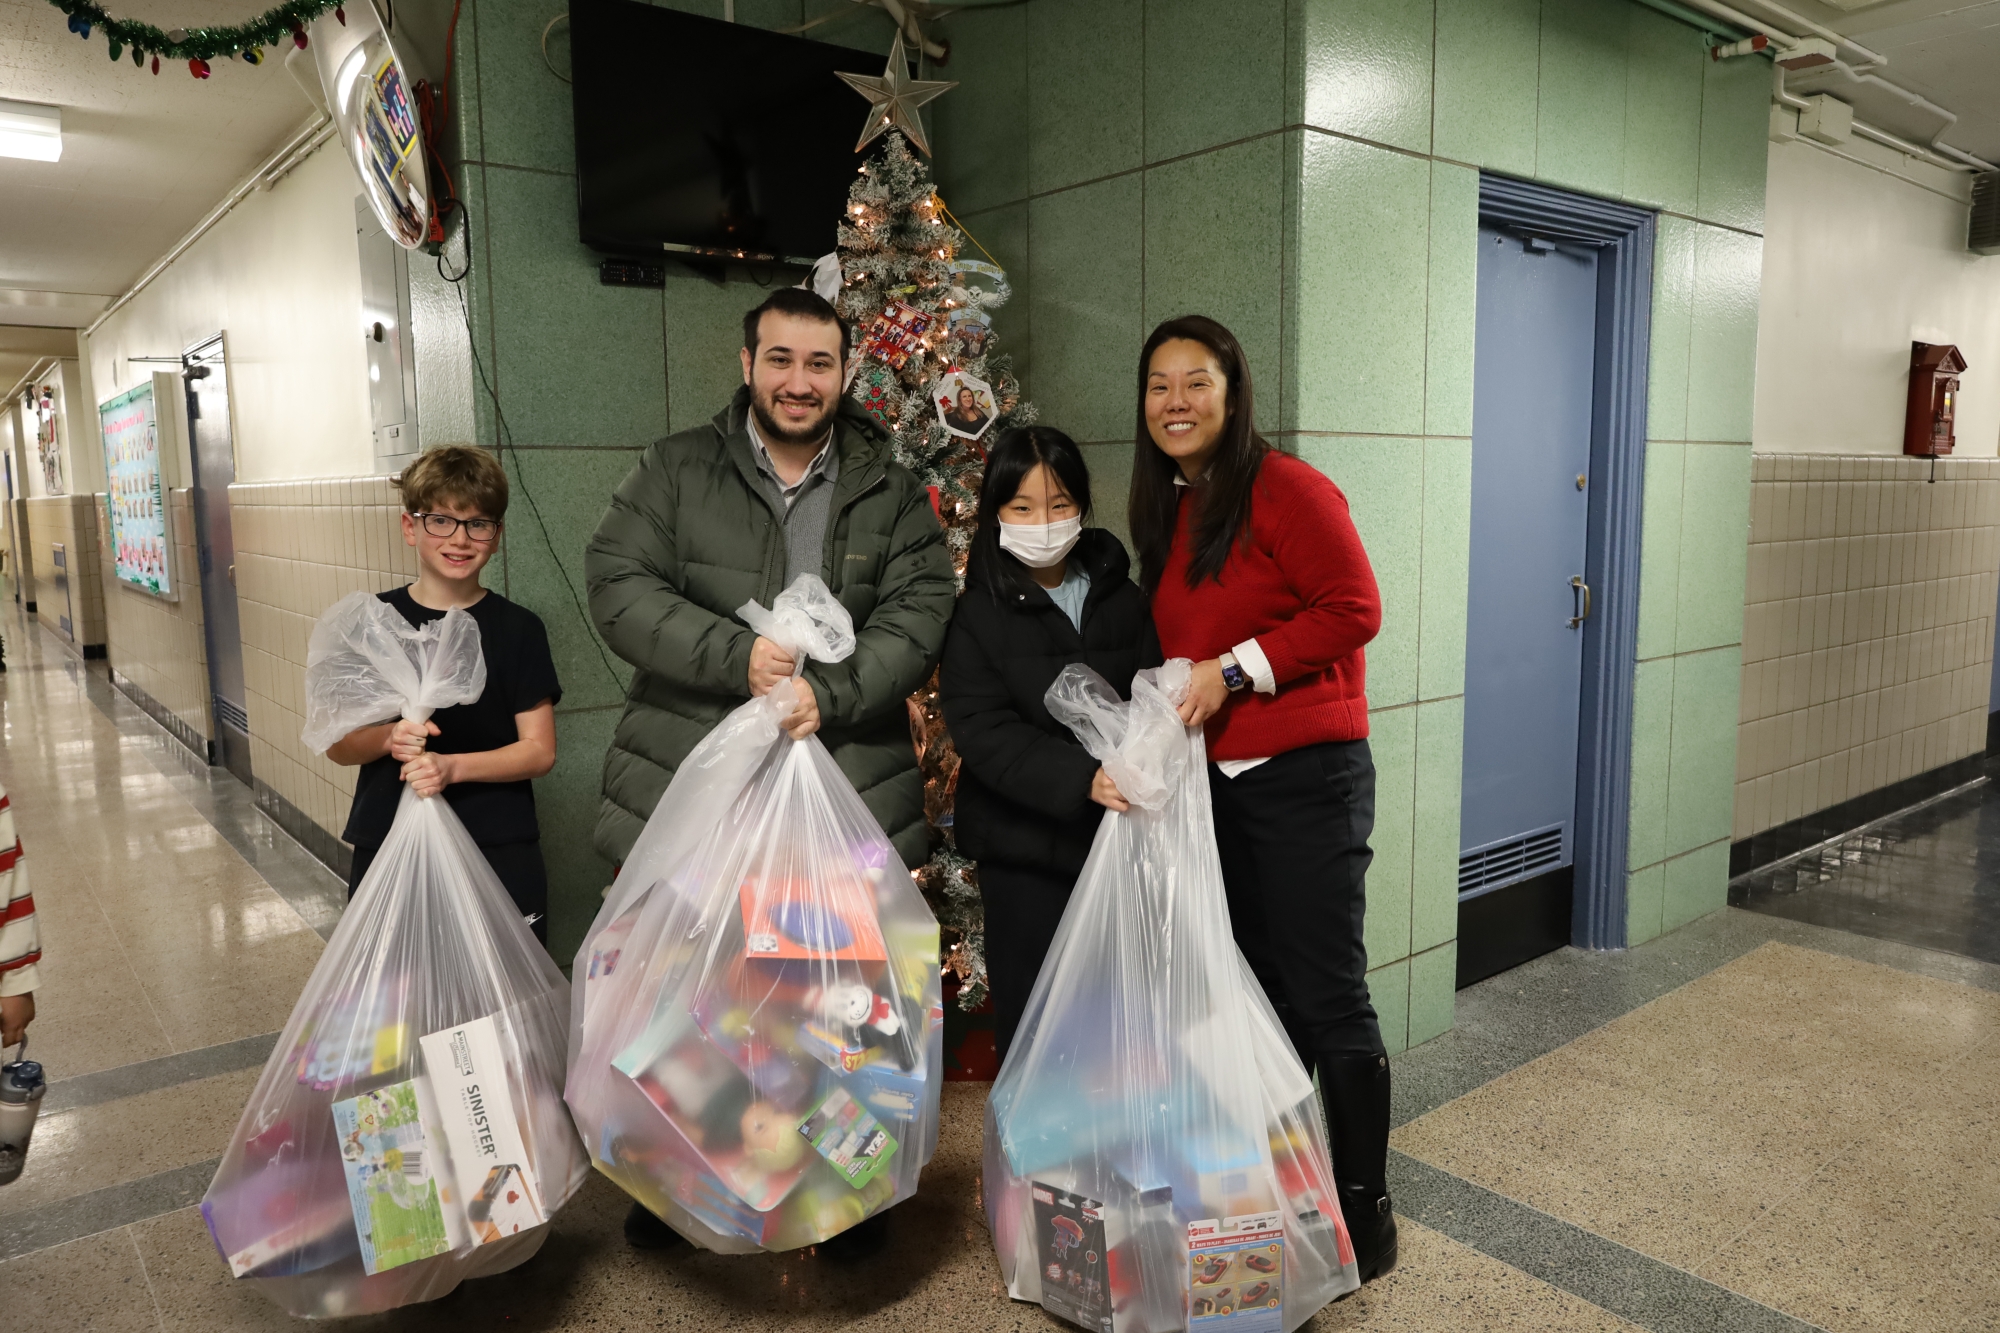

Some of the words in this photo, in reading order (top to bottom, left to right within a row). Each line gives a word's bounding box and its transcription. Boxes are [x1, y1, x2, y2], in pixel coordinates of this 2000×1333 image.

[457, 1036, 471, 1070] MAINSTREET
[460, 1088, 469, 1110] TABLE
[471, 1130, 482, 1158] HOCKEY
[864, 1130, 886, 1157] DEAL
[1191, 1241, 1196, 1249] 2
